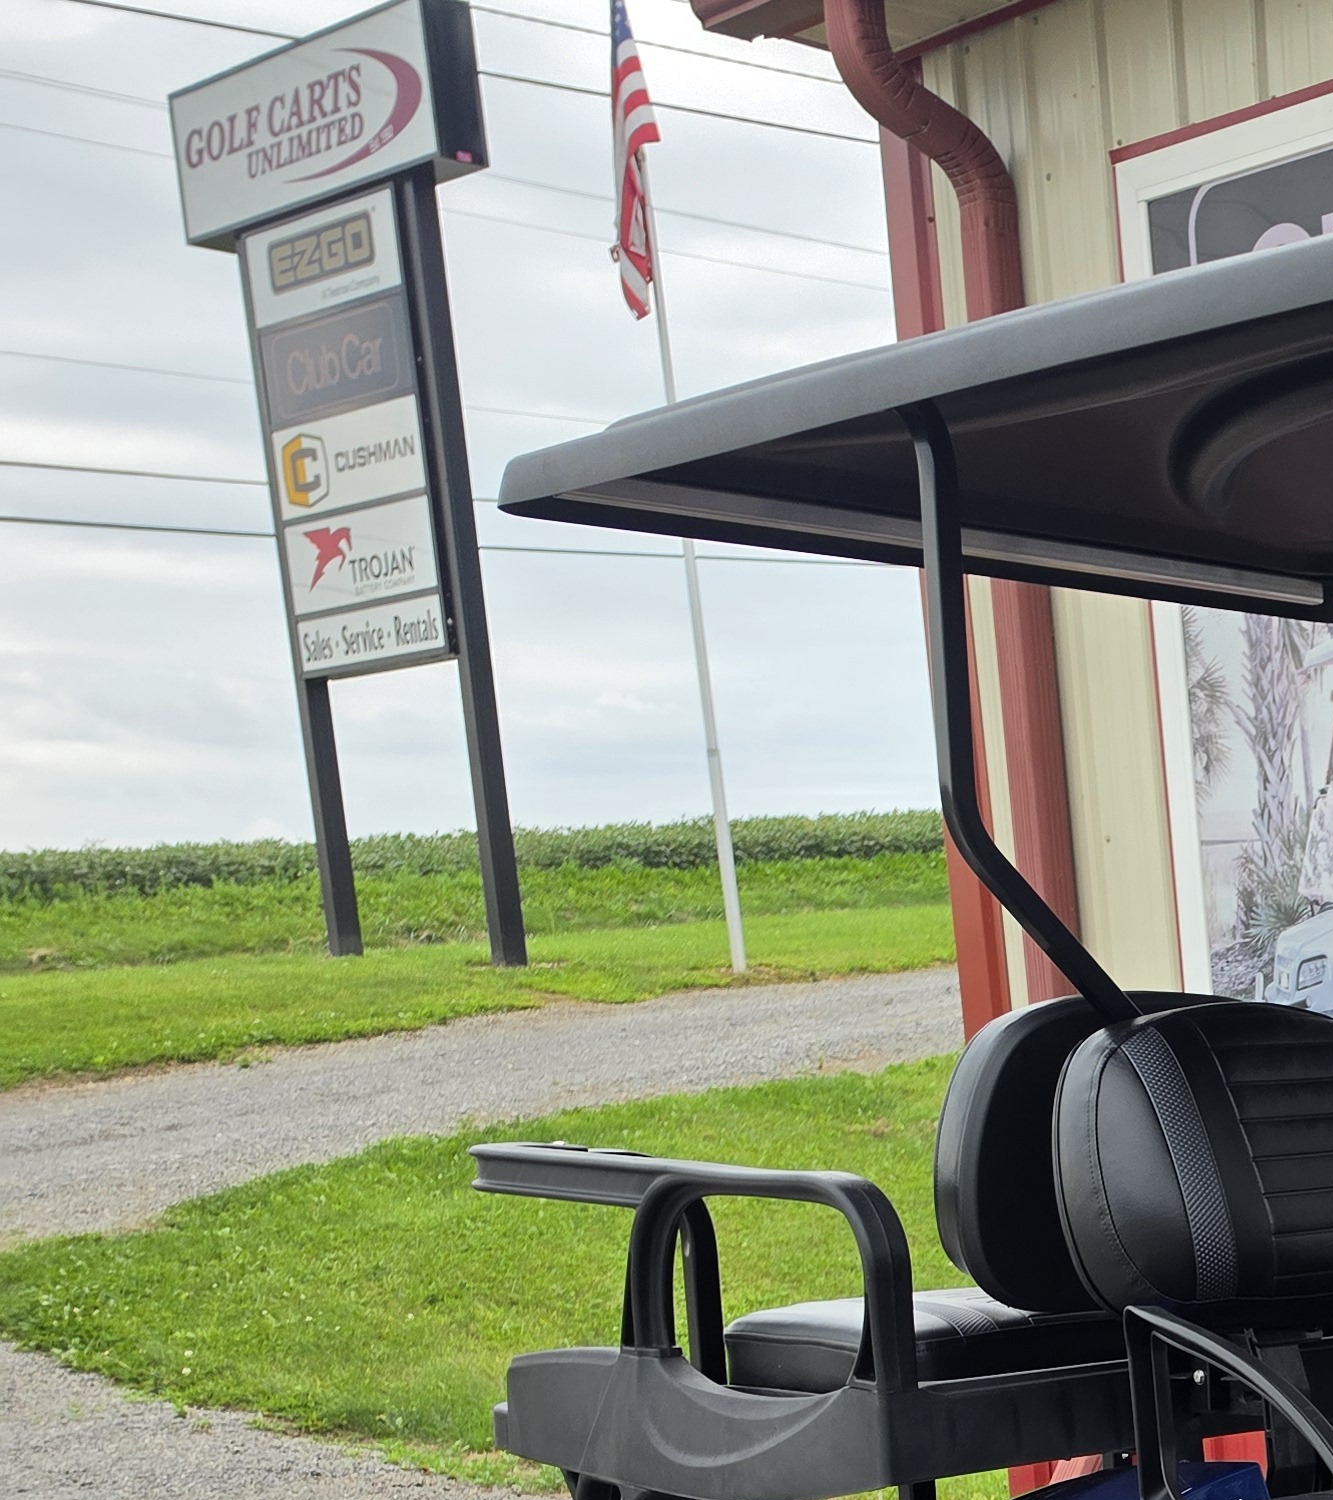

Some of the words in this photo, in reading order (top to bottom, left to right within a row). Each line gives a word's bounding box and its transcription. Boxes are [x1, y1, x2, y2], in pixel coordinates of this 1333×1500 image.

[185, 103, 261, 169] GOLF
[267, 63, 362, 138] CARTS
[247, 112, 365, 179] UNLIMITED
[286, 344, 340, 396] Club
[340, 332, 383, 380] Car
[334, 433, 415, 473] CUSHMAN
[348, 546, 415, 585] TROJAN
[303, 629, 334, 662] Sales
[341, 620, 384, 656] Service
[393, 608, 439, 647] Rentals
